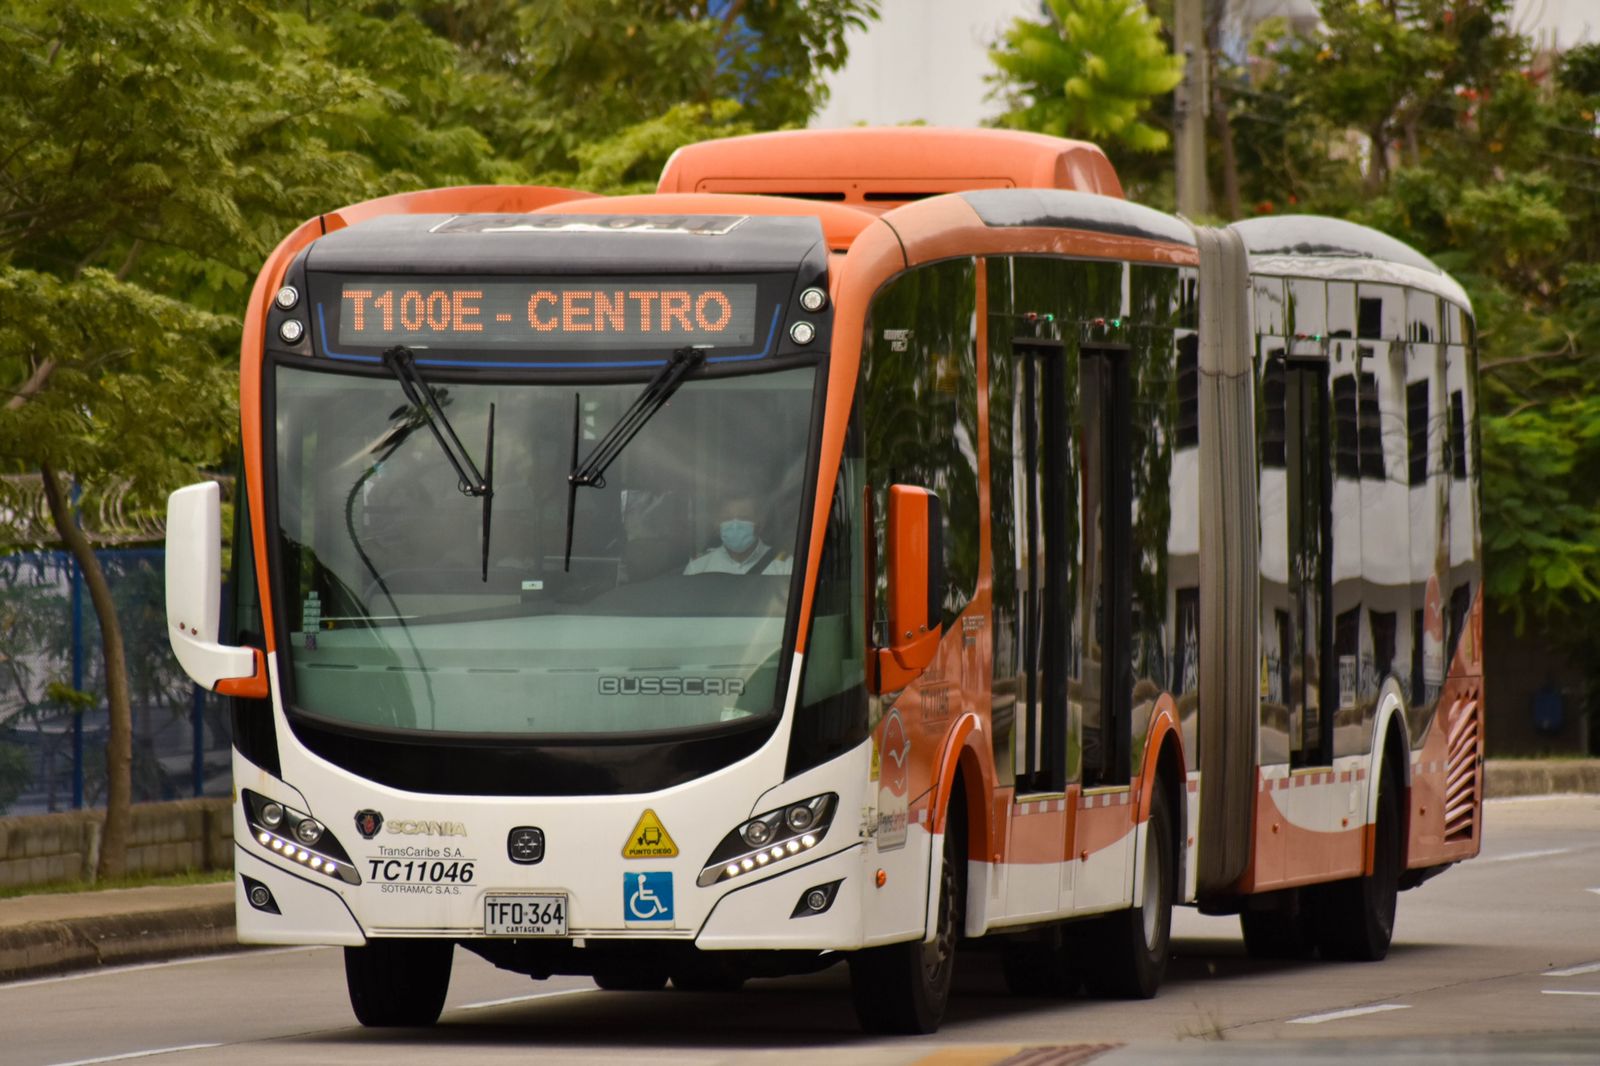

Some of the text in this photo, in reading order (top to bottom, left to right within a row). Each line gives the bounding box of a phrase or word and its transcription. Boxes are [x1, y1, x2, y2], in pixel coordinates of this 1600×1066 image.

[342, 290, 484, 332] T100E
[527, 290, 732, 332] CENTRO
[598, 676, 745, 696] BUSSCAR
[386, 820, 467, 837] SCANIA
[378, 846, 465, 858] TransCaribe S.A.
[368, 860, 475, 883] TC11046
[381, 885, 462, 895] SOTRAMAC S.A.S.
[506, 926, 545, 934] CARTAGENA
